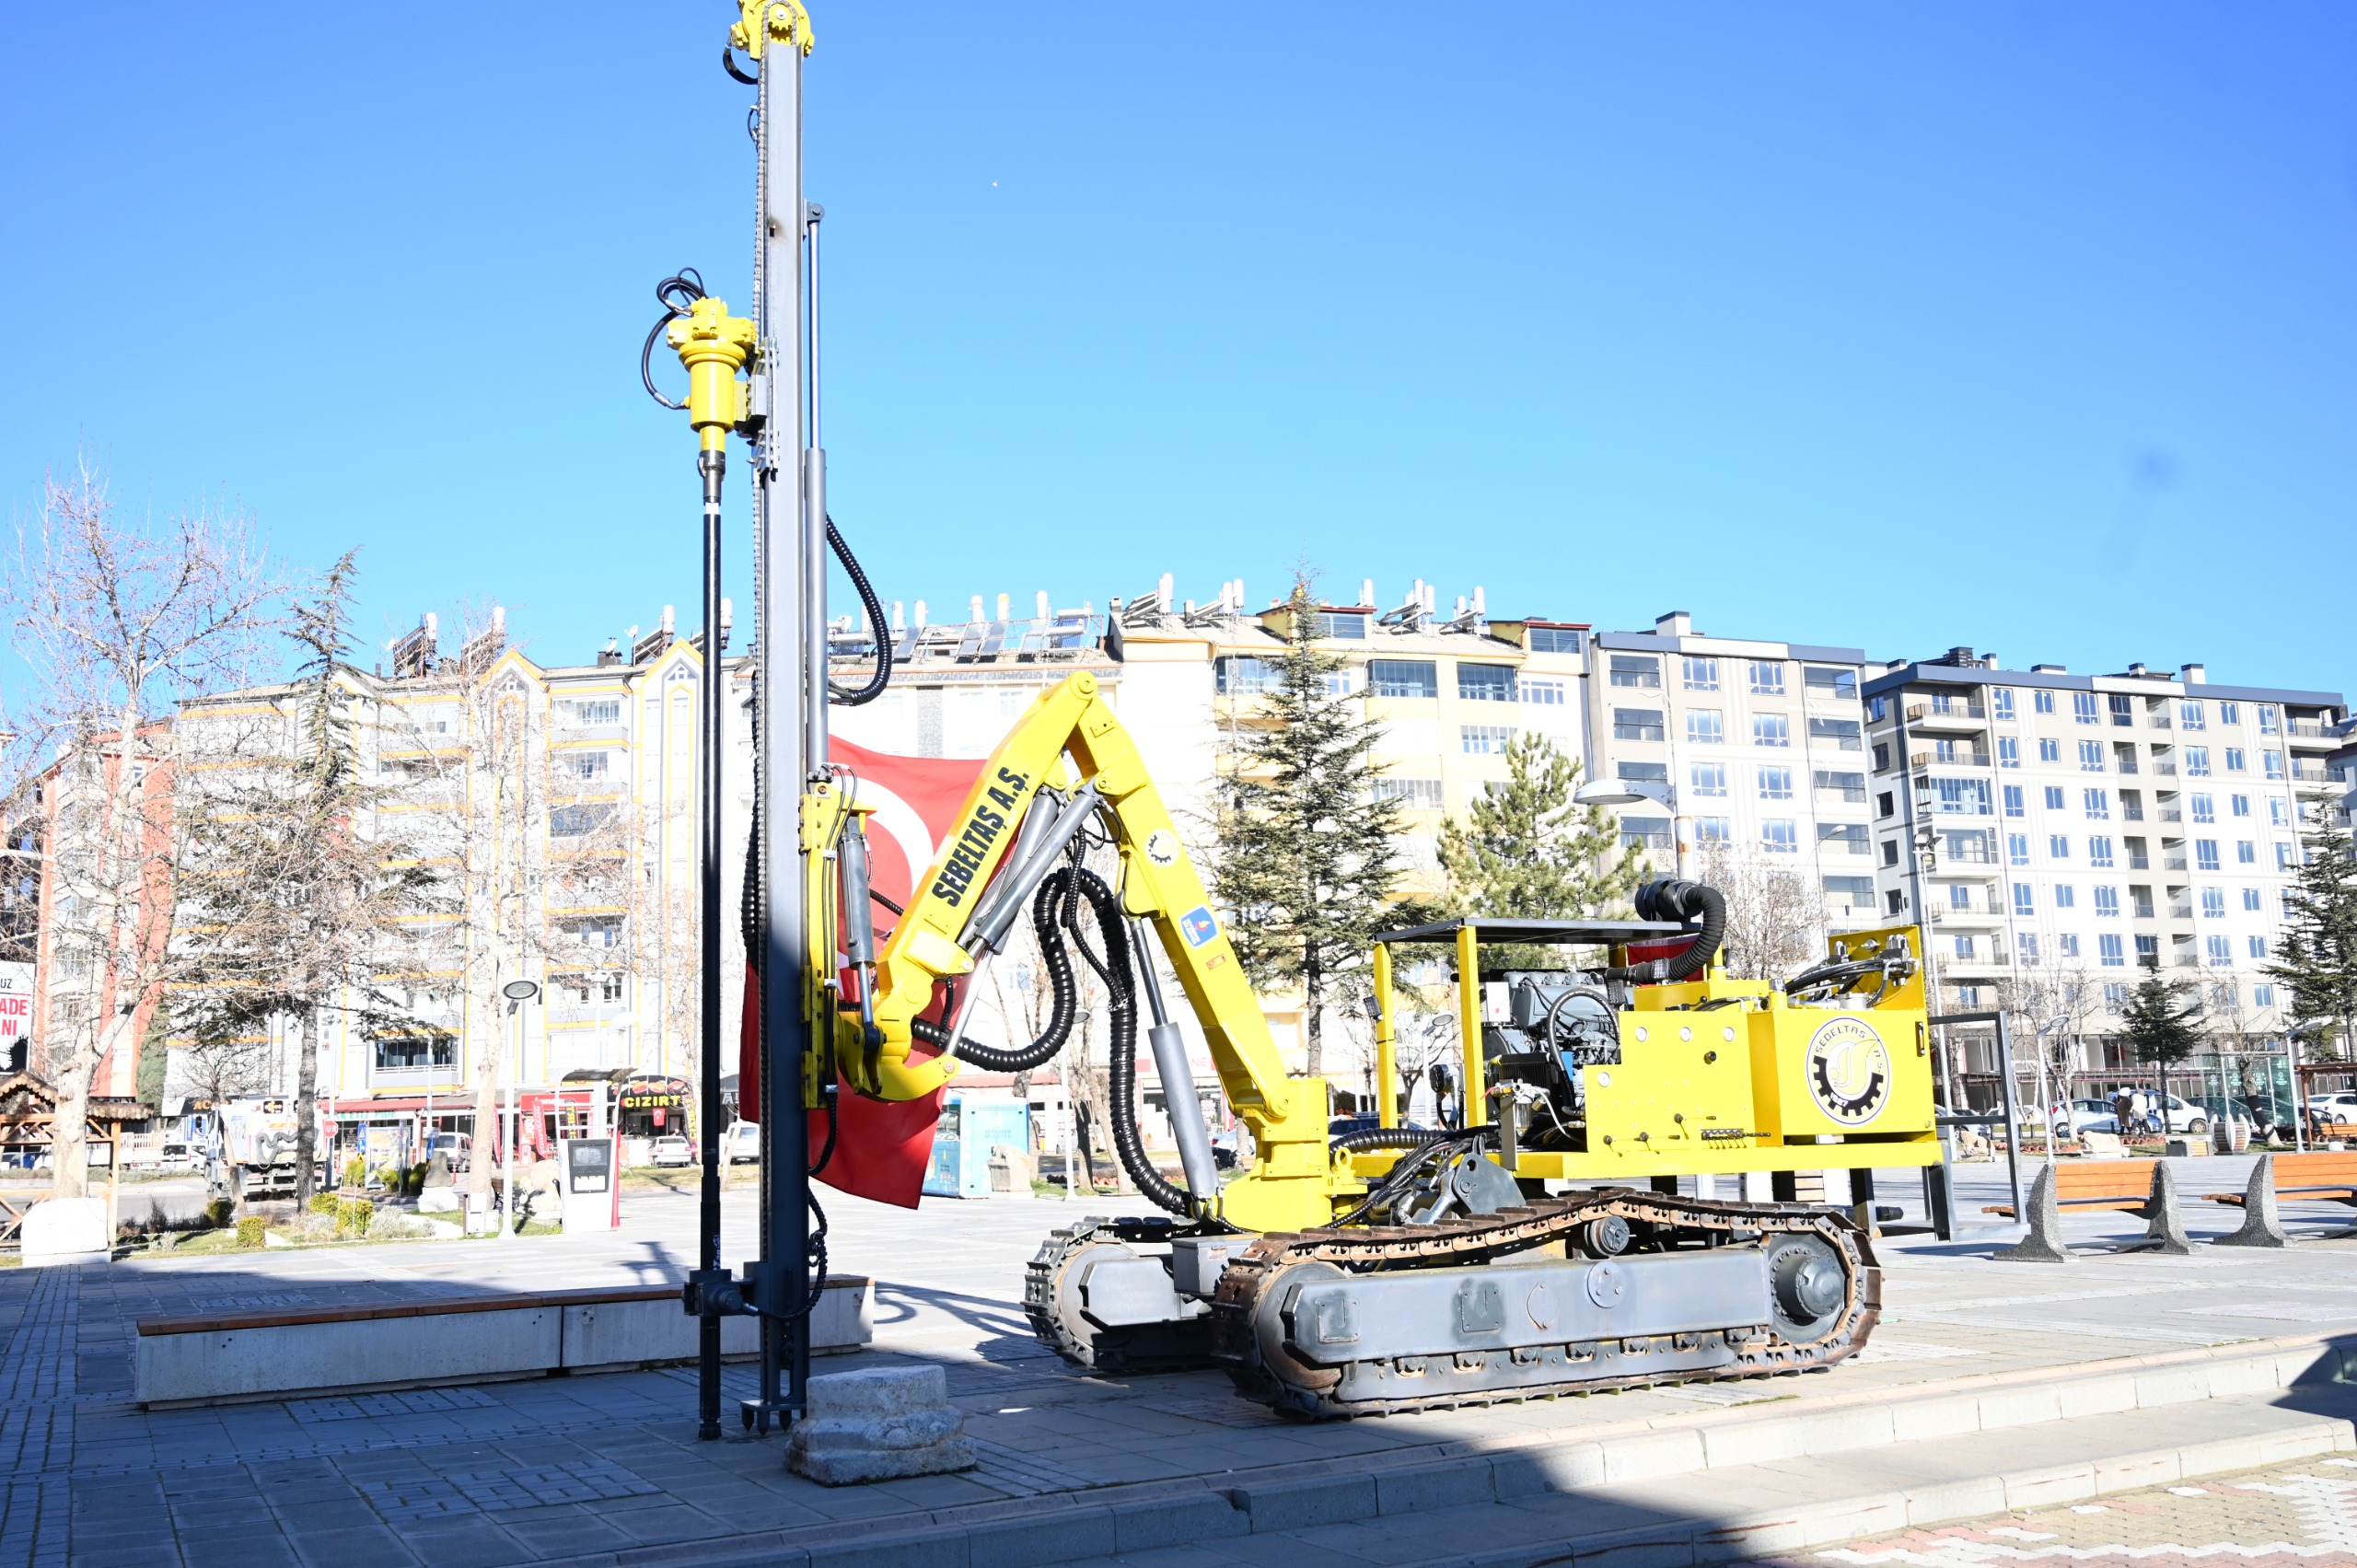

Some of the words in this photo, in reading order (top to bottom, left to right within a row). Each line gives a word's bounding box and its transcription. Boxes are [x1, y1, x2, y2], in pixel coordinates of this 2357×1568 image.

[932, 805, 1007, 907] SEBELTAŞ
[987, 767, 1029, 811] A.Ş.
[624, 1095, 681, 1108] CIZIRT
[326, 1125, 337, 1133] UR
